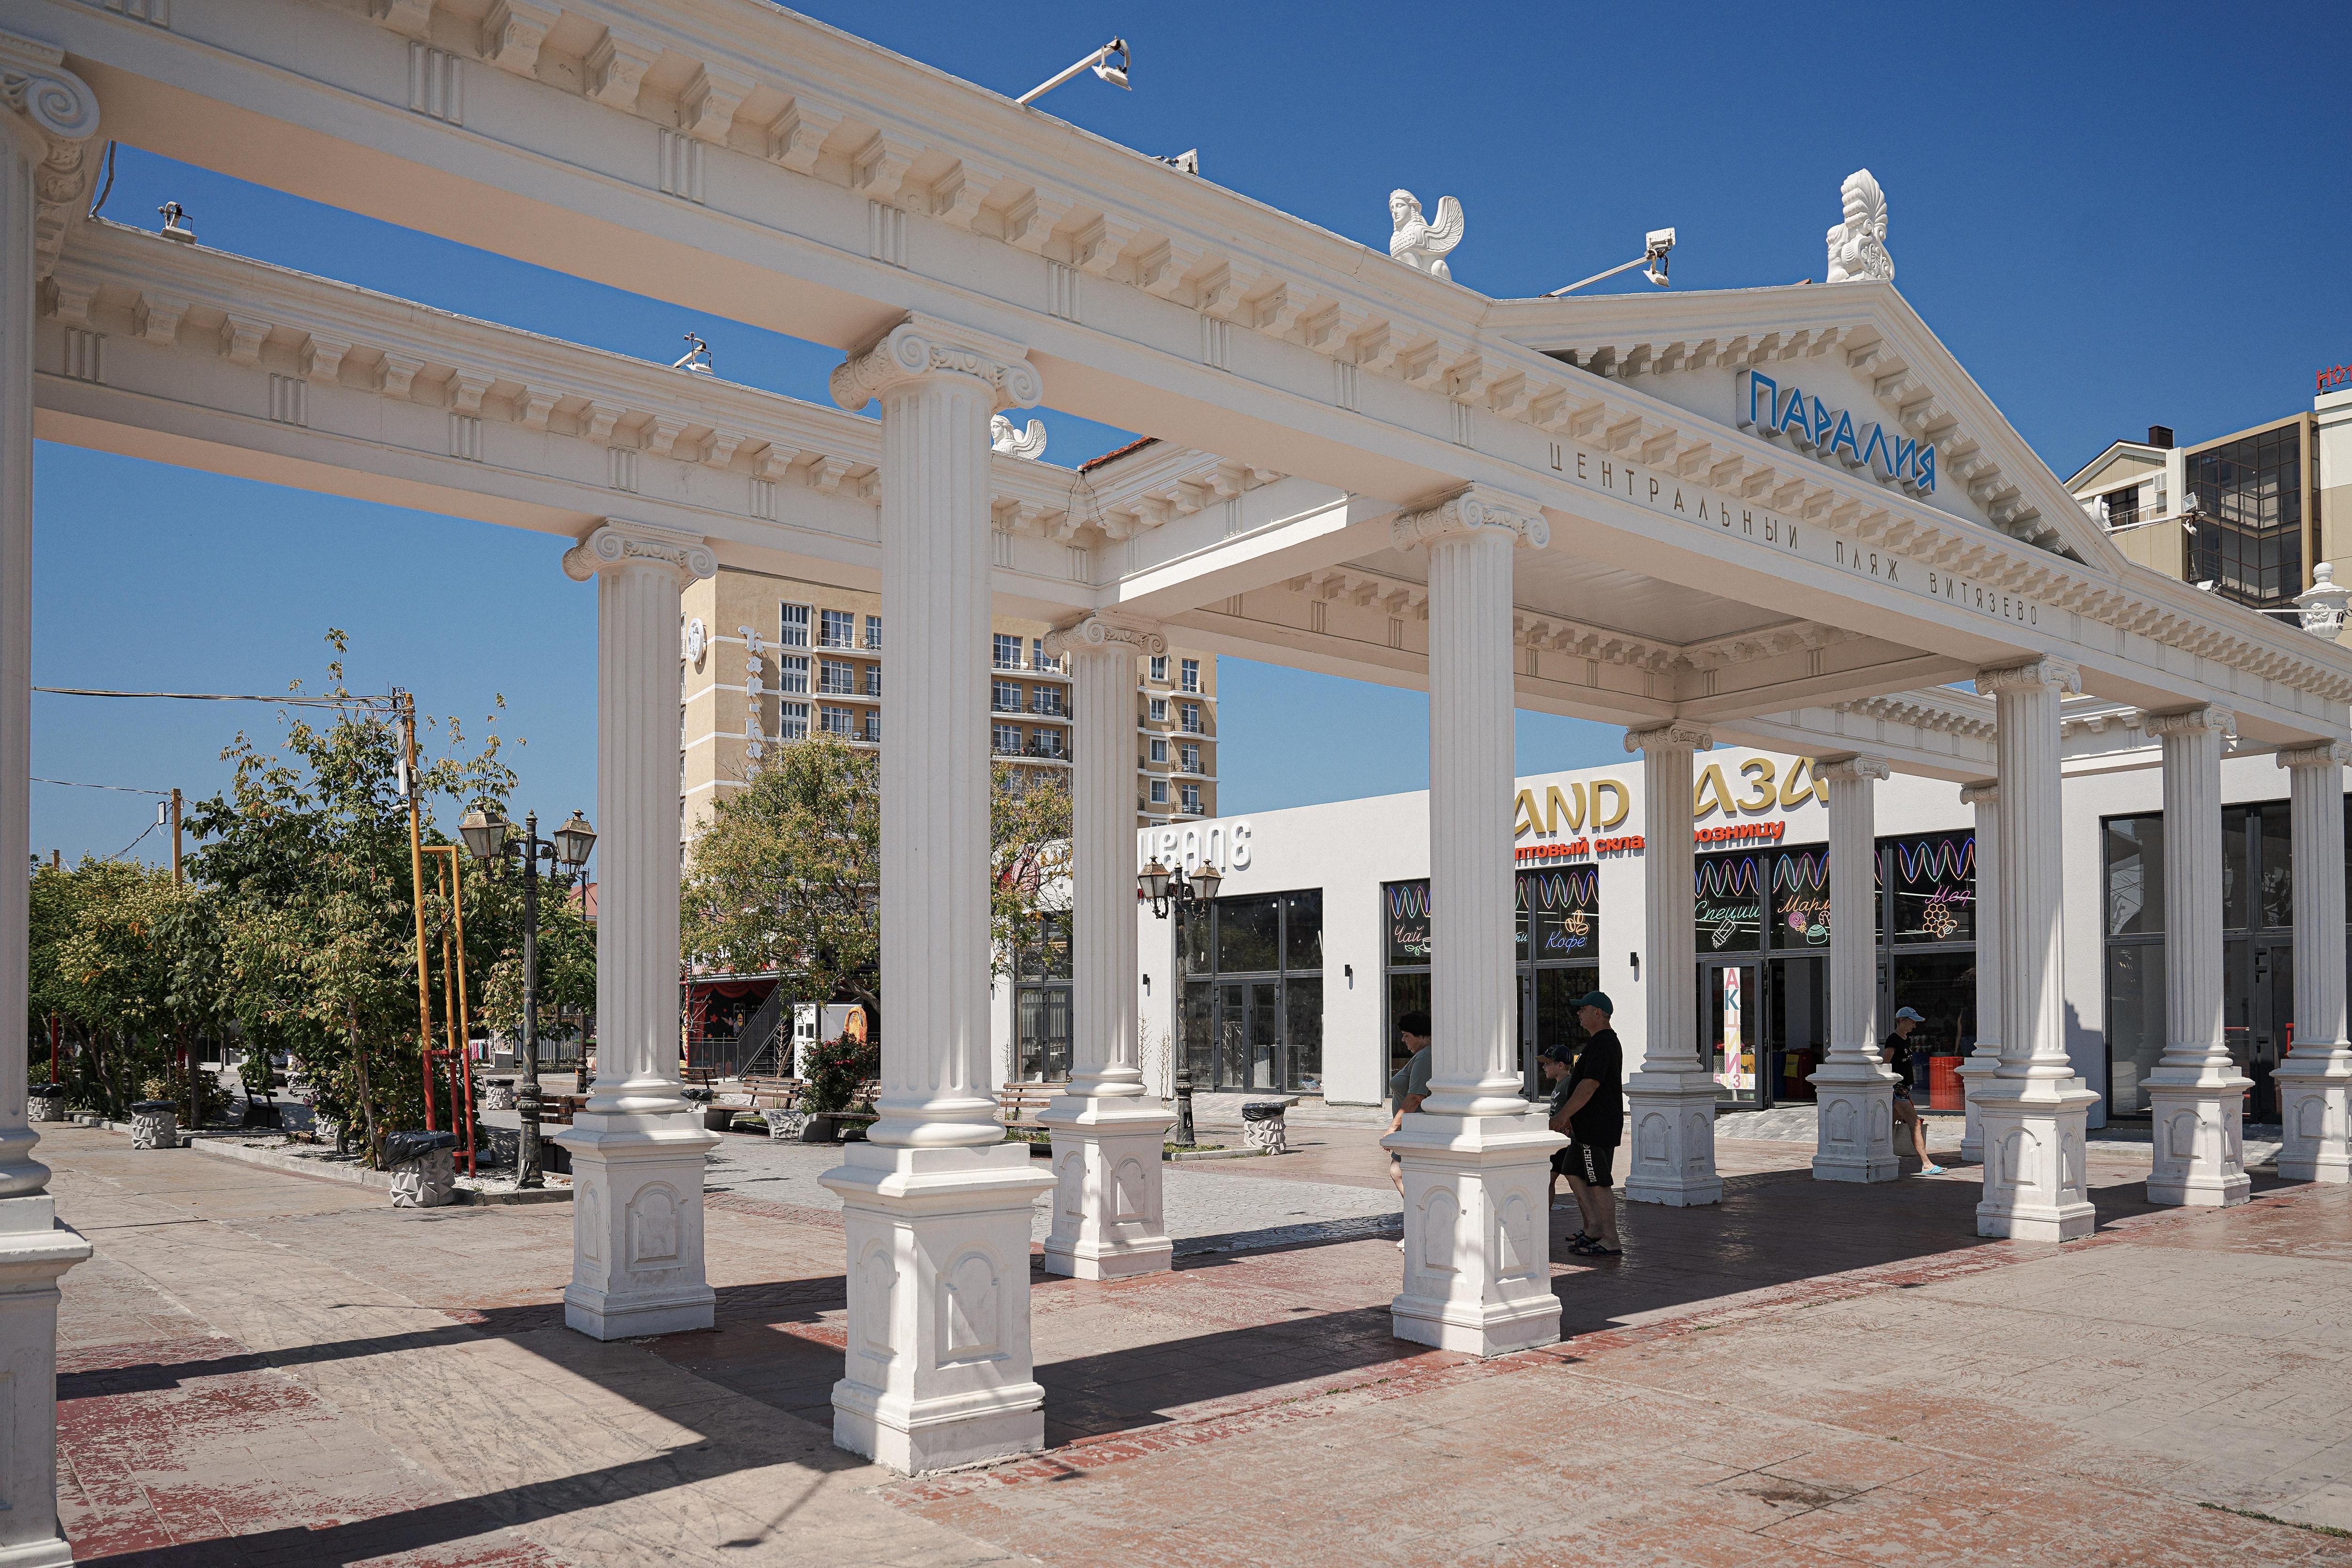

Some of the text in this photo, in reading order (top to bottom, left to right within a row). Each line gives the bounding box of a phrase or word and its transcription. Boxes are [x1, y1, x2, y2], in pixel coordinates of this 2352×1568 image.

[1748, 368, 1937, 494] ПАРАЛИЯ
[1836, 540, 1899, 582] ПЛЯЖ
[1929, 572, 2037, 625] ВИТЯЗЕВО
[1515, 821, 1786, 860] птовый скла озницу
[1694, 900, 1760, 921] Специи
[1925, 885, 1971, 907] Мед
[1395, 925, 1422, 943] Чай
[1545, 931, 1586, 954] Кофе
[1725, 968, 1740, 1074] АКЦИИ
